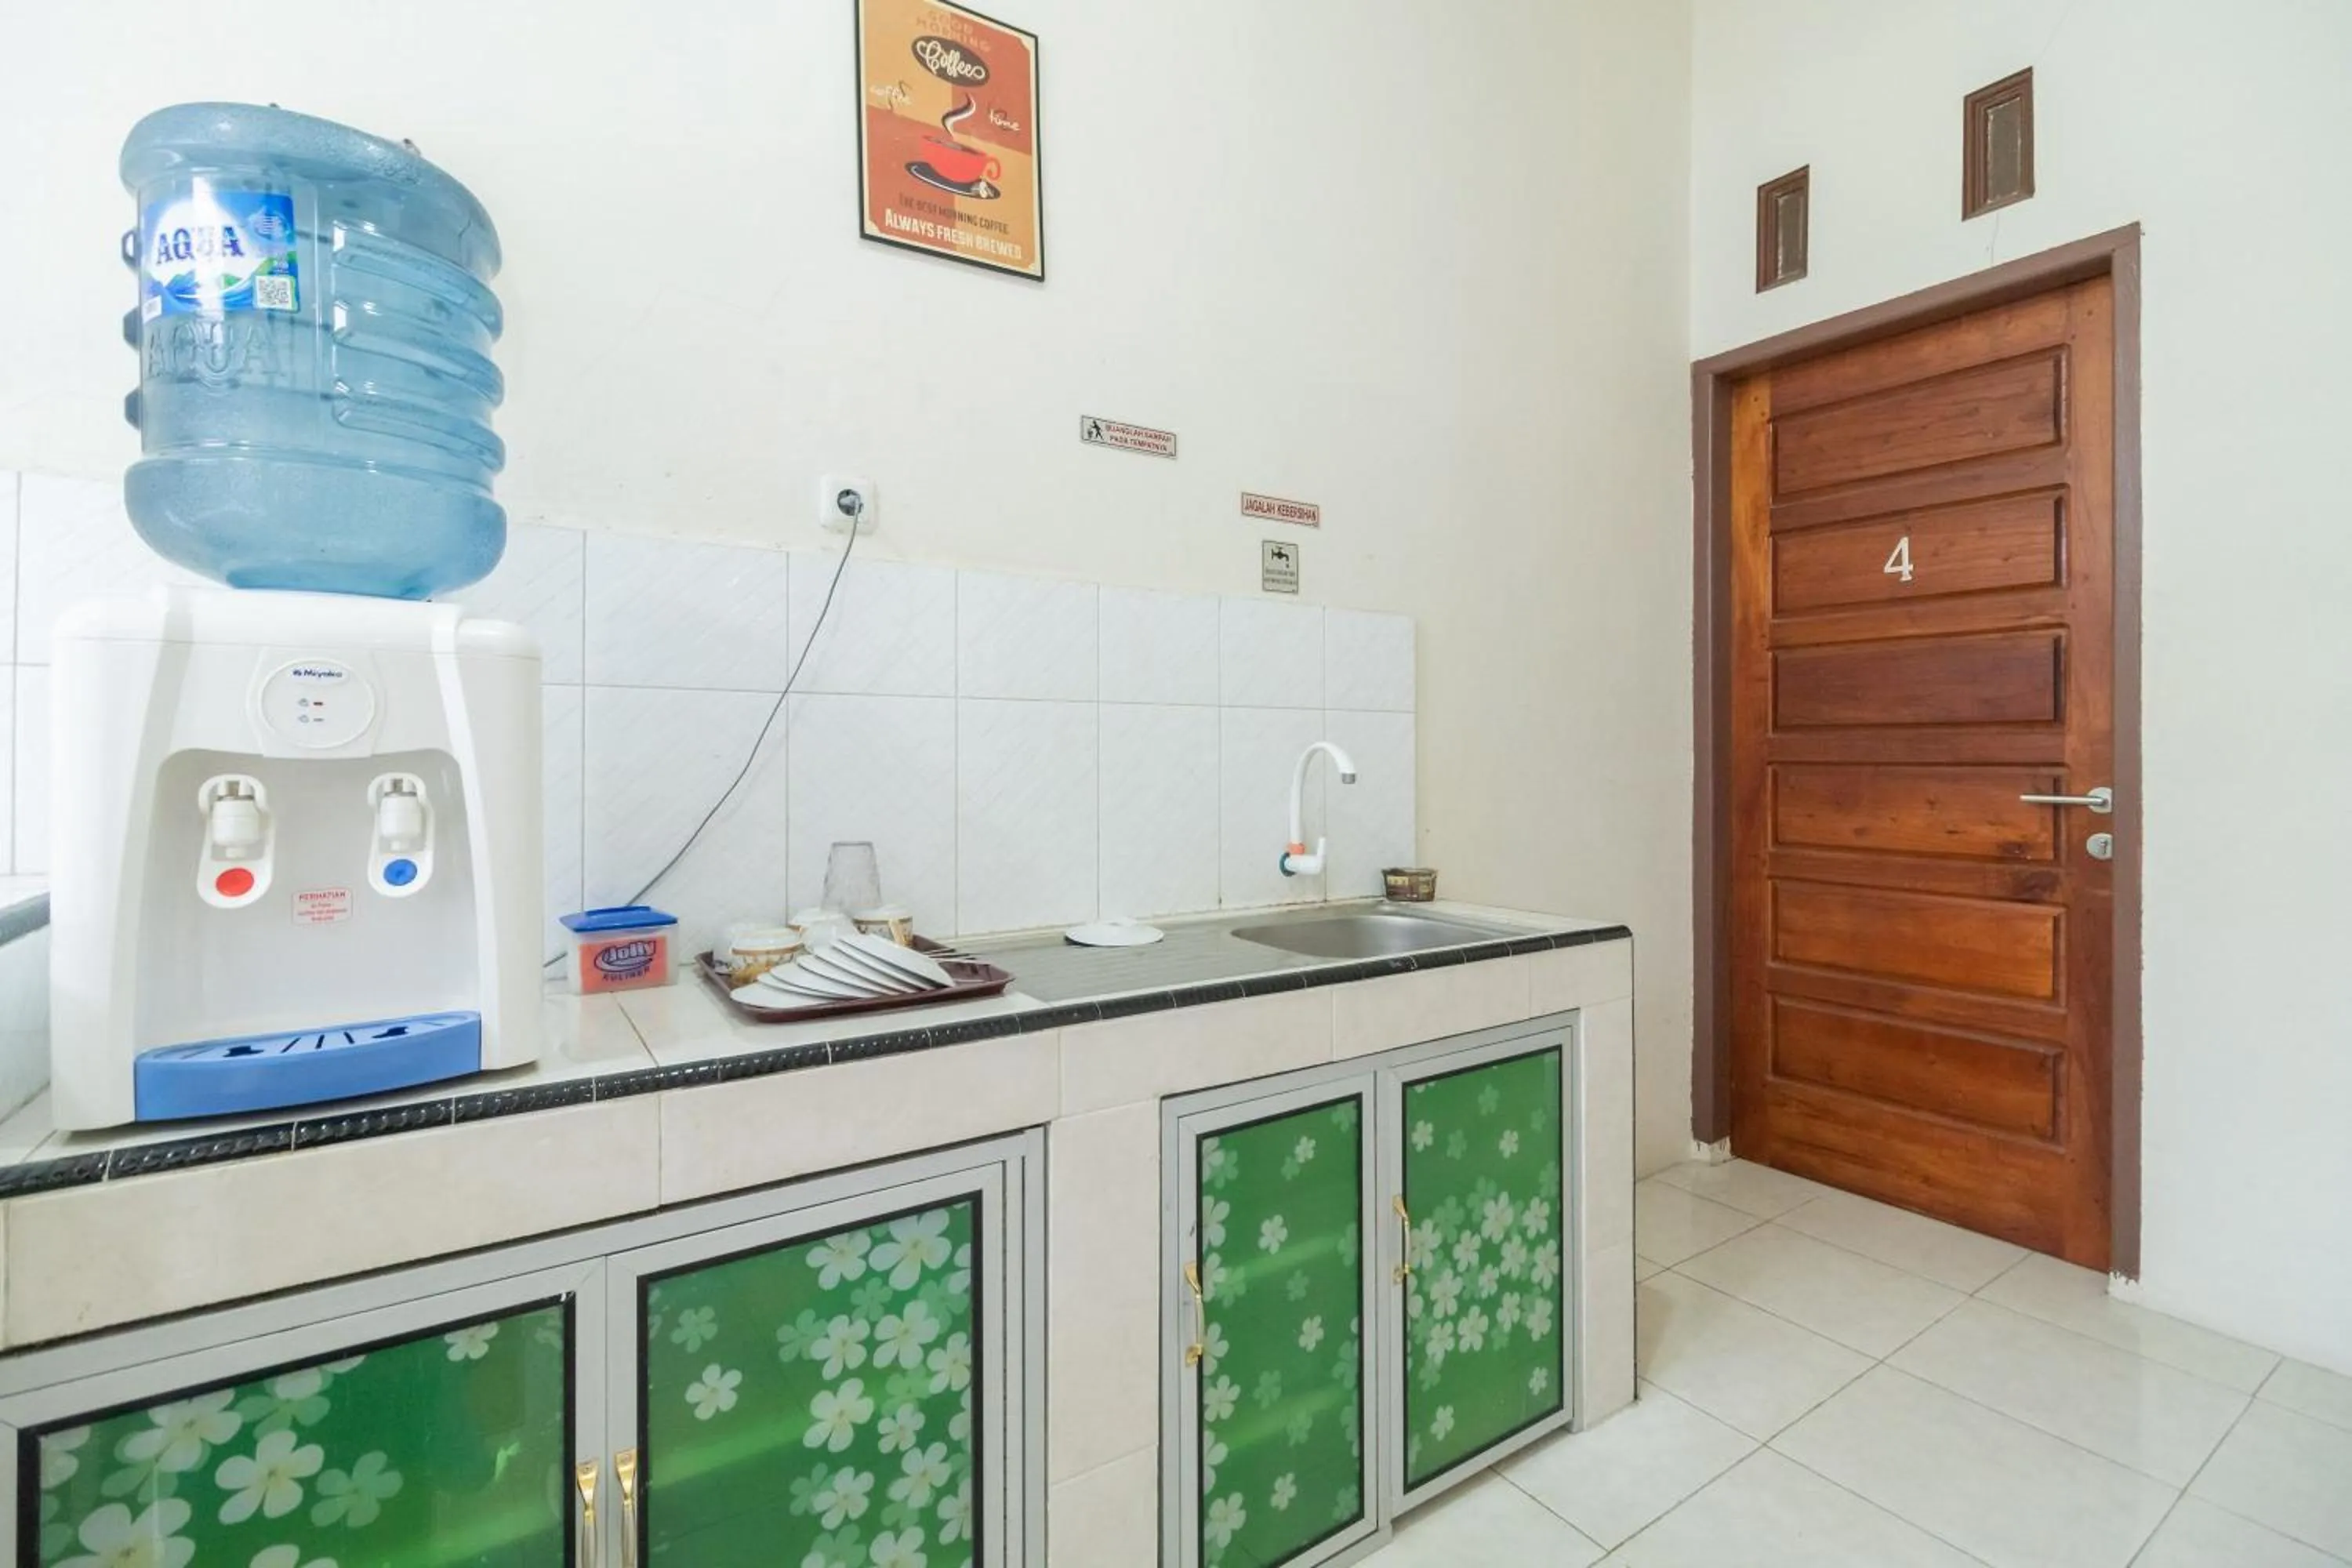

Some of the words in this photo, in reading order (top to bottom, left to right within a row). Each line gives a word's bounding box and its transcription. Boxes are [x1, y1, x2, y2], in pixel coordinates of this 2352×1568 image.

[916, 40, 985, 79] Coffee
[885, 208, 935, 238] ALWAYS
[937, 224, 974, 249] FRESH
[975, 236, 1022, 260] BREWED
[899, 193, 913, 209] THE
[916, 199, 937, 214] BEST
[938, 205, 978, 227] MORNING
[979, 216, 1010, 234] COFFEE
[155, 226, 245, 266] AQUA
[147, 321, 287, 383] AQUA
[1244, 498, 1276, 515] JAGALAH
[1276, 503, 1317, 521] KEBERSIHAN
[1883, 536, 1914, 582] 4
